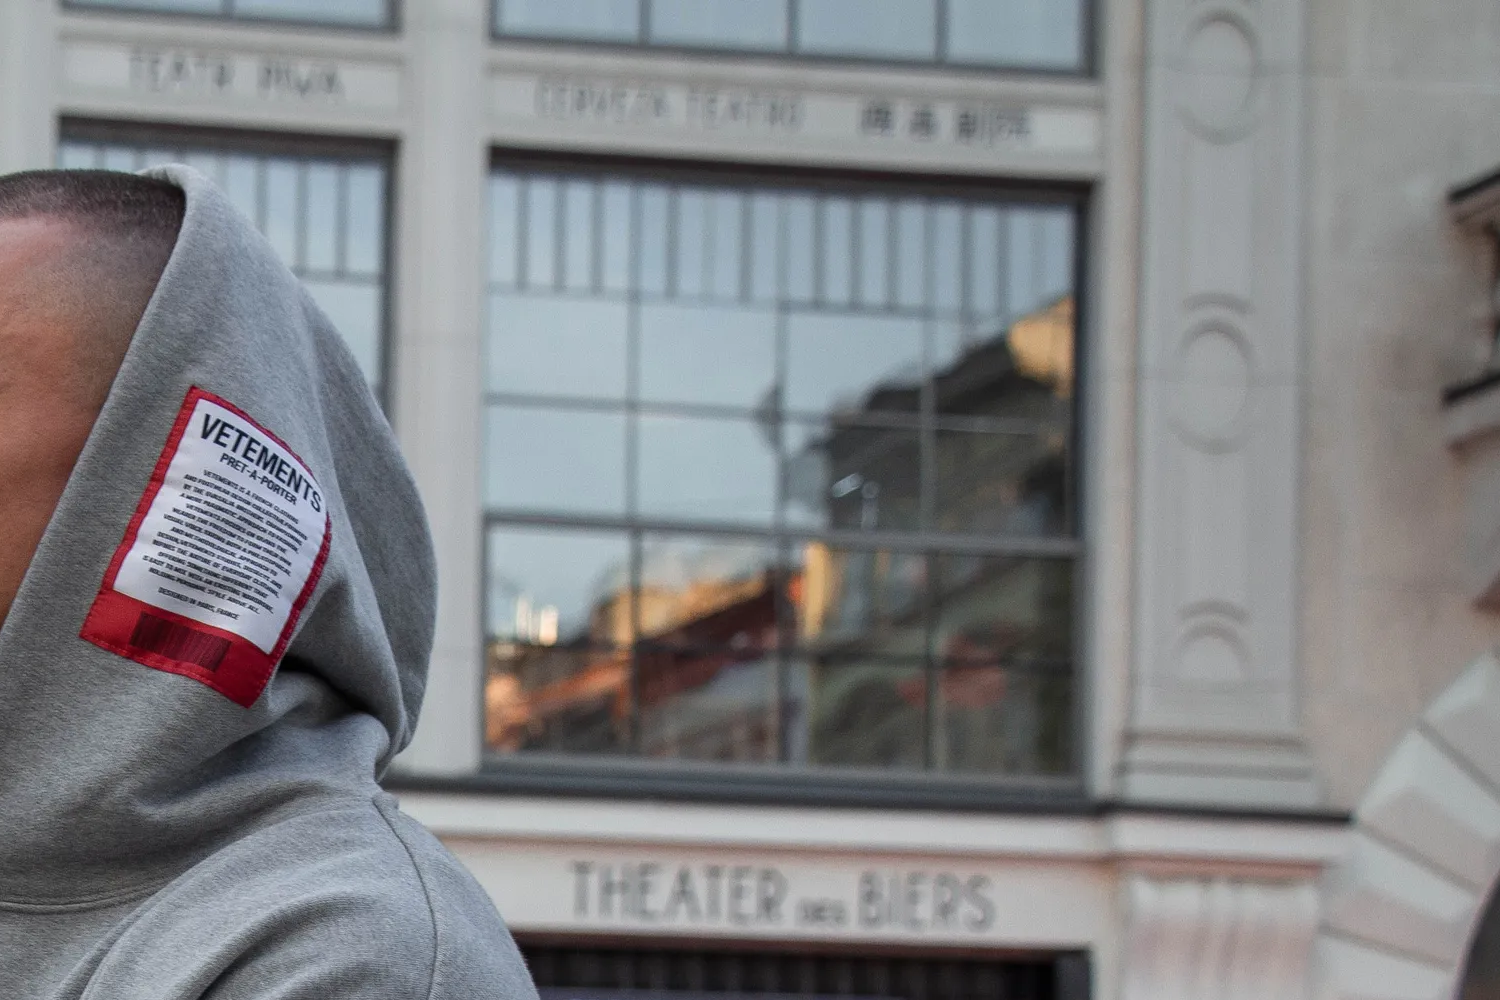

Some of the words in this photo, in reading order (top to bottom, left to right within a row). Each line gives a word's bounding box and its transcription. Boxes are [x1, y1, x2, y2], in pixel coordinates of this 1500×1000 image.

[201, 413, 321, 513] VETEMENTS
[220, 453, 298, 506] PRET-A-PORTER
[573, 860, 788, 925] THEATER
[858, 872, 996, 932] BIERS
